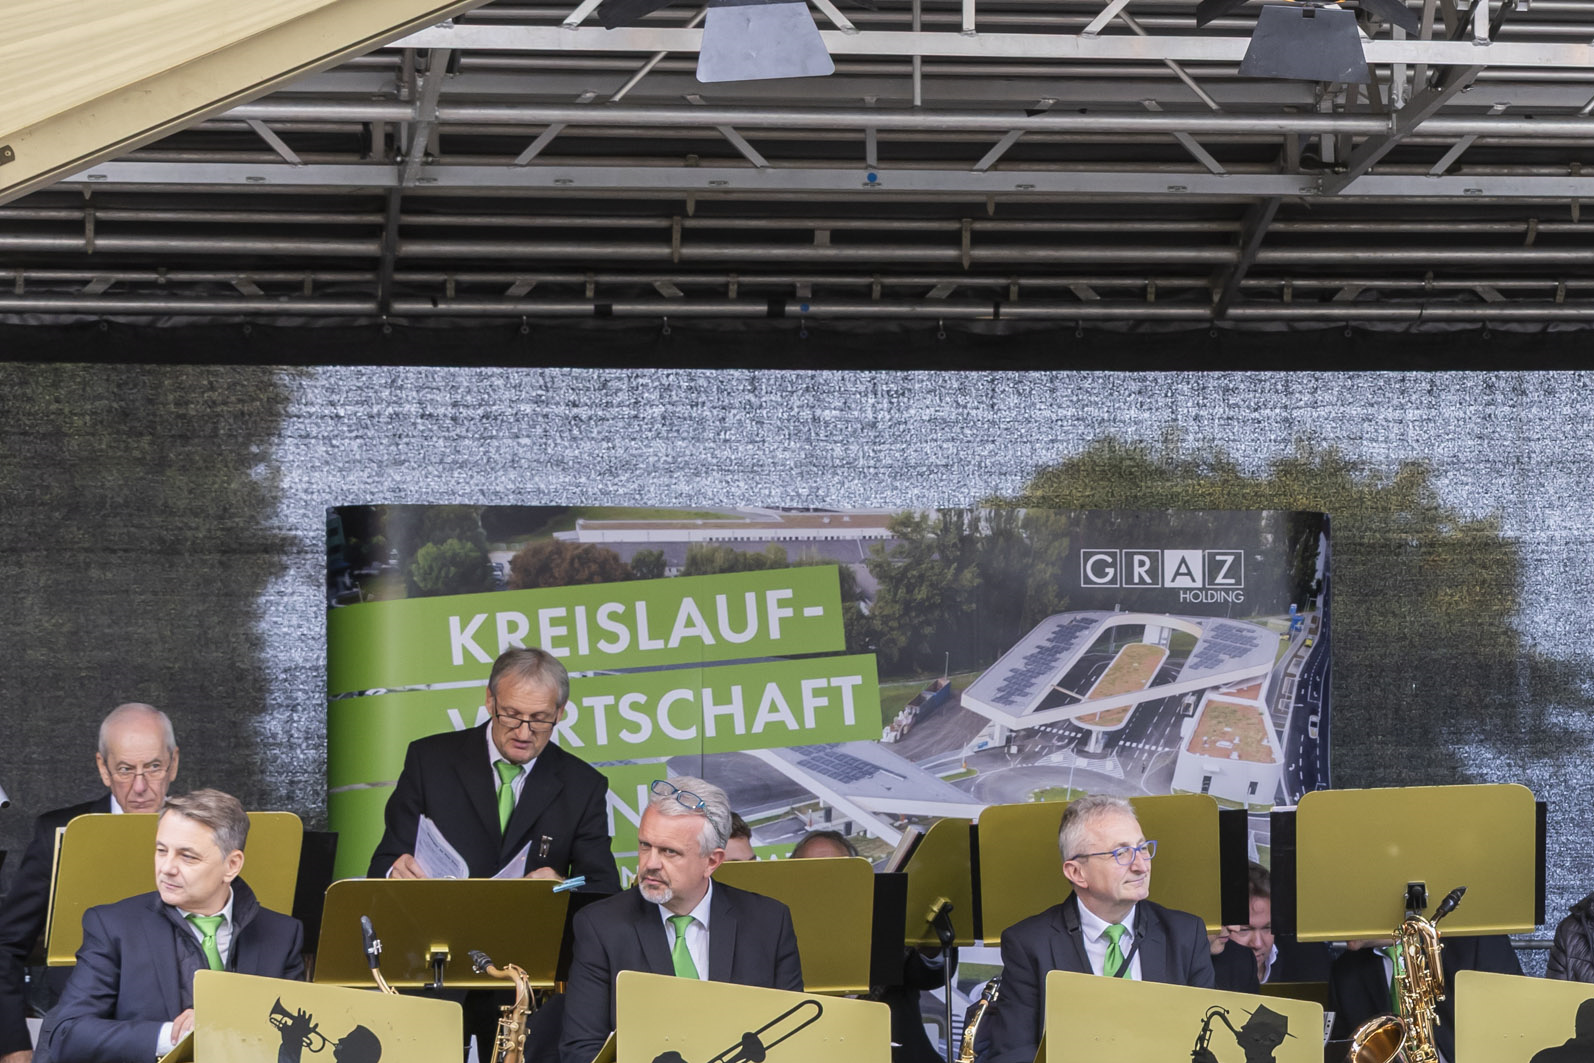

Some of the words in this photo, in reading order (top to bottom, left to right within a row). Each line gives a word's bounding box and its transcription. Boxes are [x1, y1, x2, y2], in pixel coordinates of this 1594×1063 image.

[1082, 550, 1241, 587] GRAZ
[1179, 590, 1244, 603] HOLDING
[449, 588, 824, 666] KREISLAUF-
[447, 675, 862, 748] RTSCHAFT
